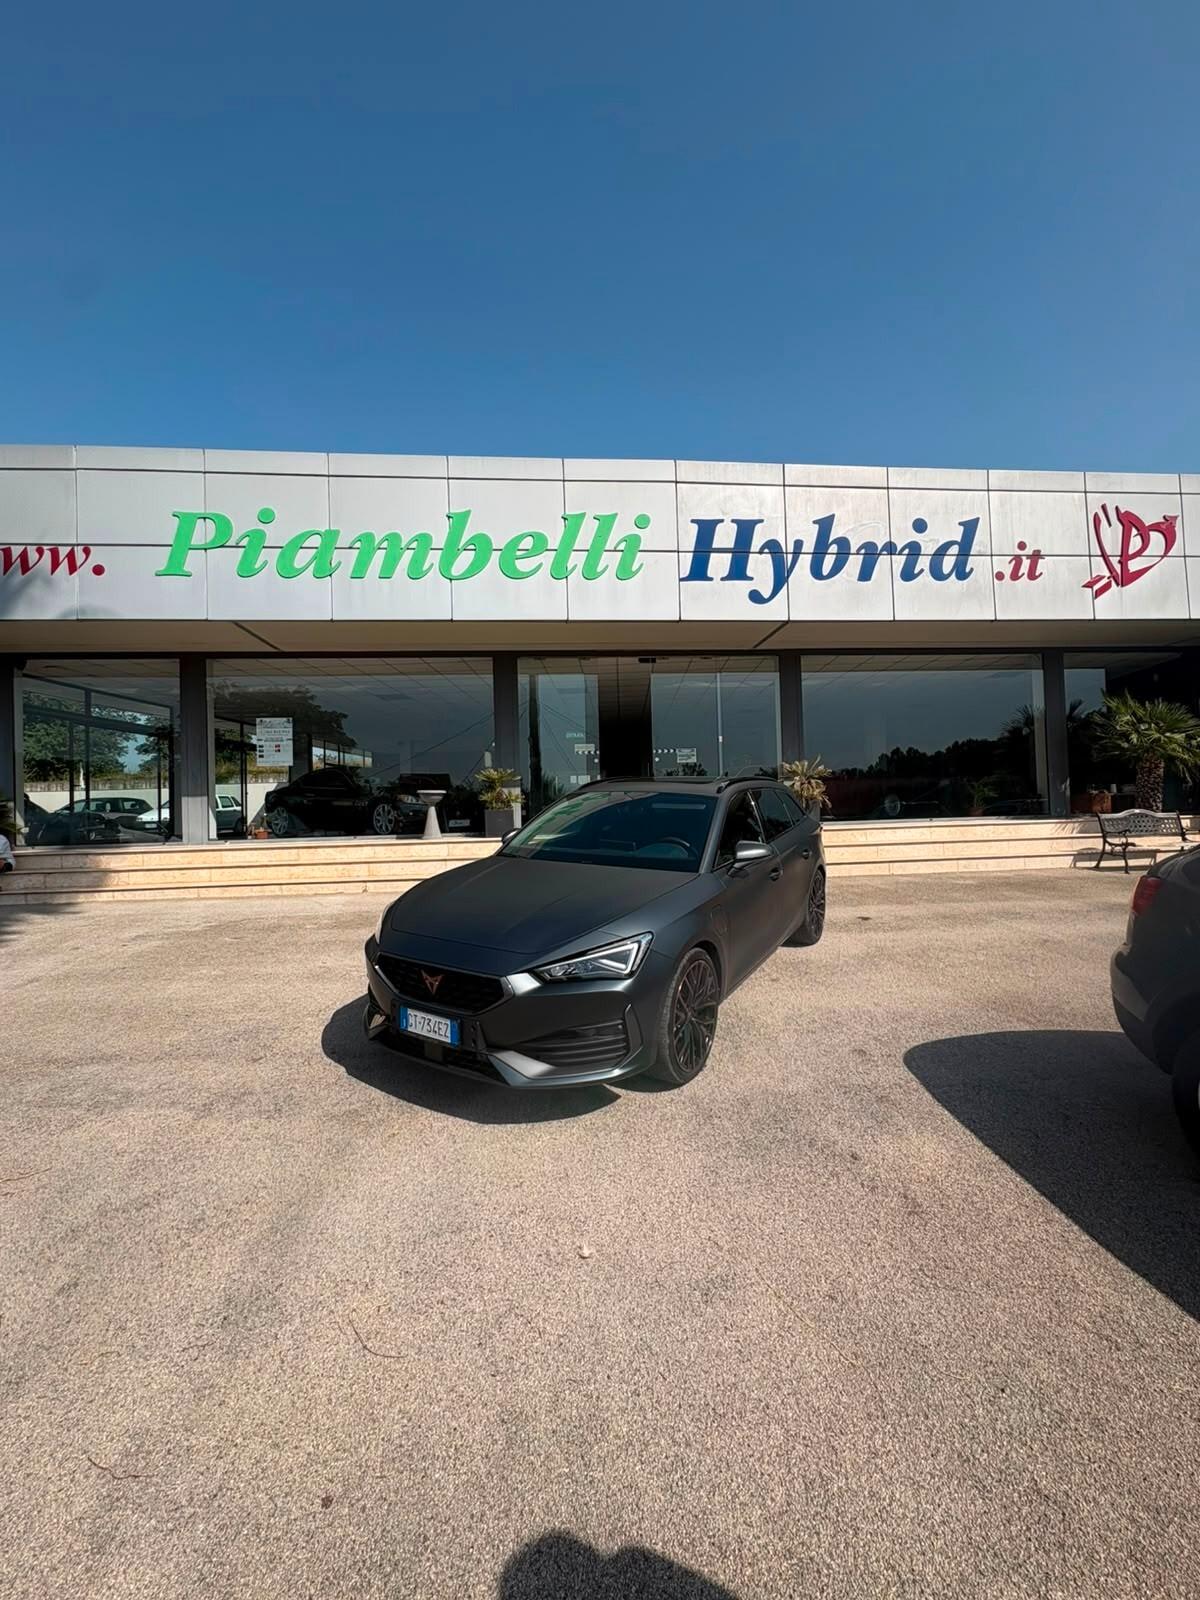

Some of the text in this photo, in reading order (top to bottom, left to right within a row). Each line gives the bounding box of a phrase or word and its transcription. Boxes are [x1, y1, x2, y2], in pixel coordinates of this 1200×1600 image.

[155, 508, 651, 581] Piambelli
[680, 513, 980, 604] Hybrid
[994, 541, 1045, 581] .it
